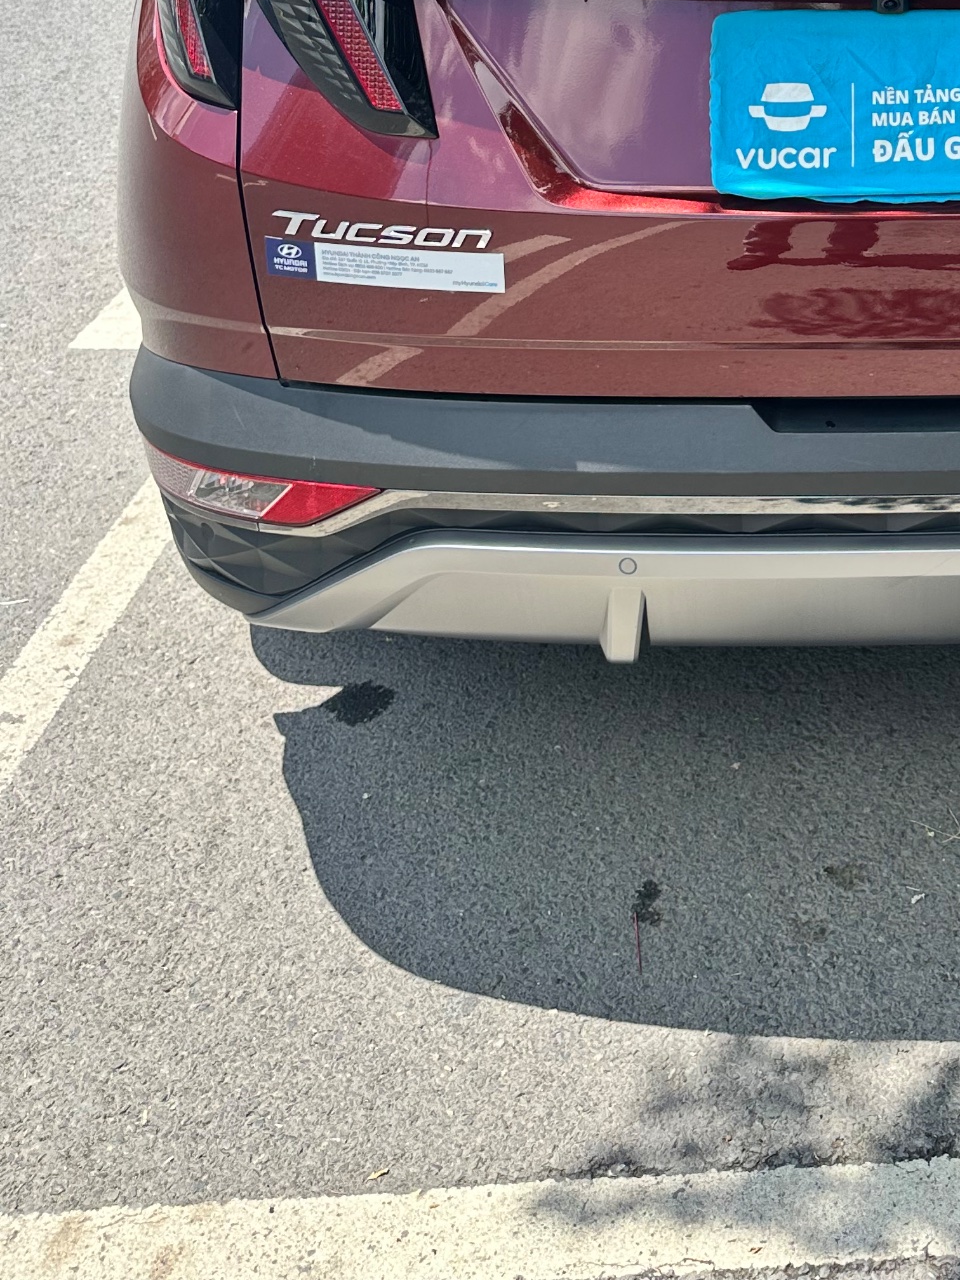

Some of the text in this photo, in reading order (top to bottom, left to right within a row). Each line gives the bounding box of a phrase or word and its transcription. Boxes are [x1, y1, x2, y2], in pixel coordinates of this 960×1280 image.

[871, 85, 910, 106] NỀN
[871, 111, 914, 128] MUA
[918, 106, 956, 126] BÁN
[872, 129, 935, 163] ĐẤU
[735, 146, 838, 170] vucar
[273, 257, 308, 267] HYUNDAI
[284, 265, 308, 273] MOTOR
